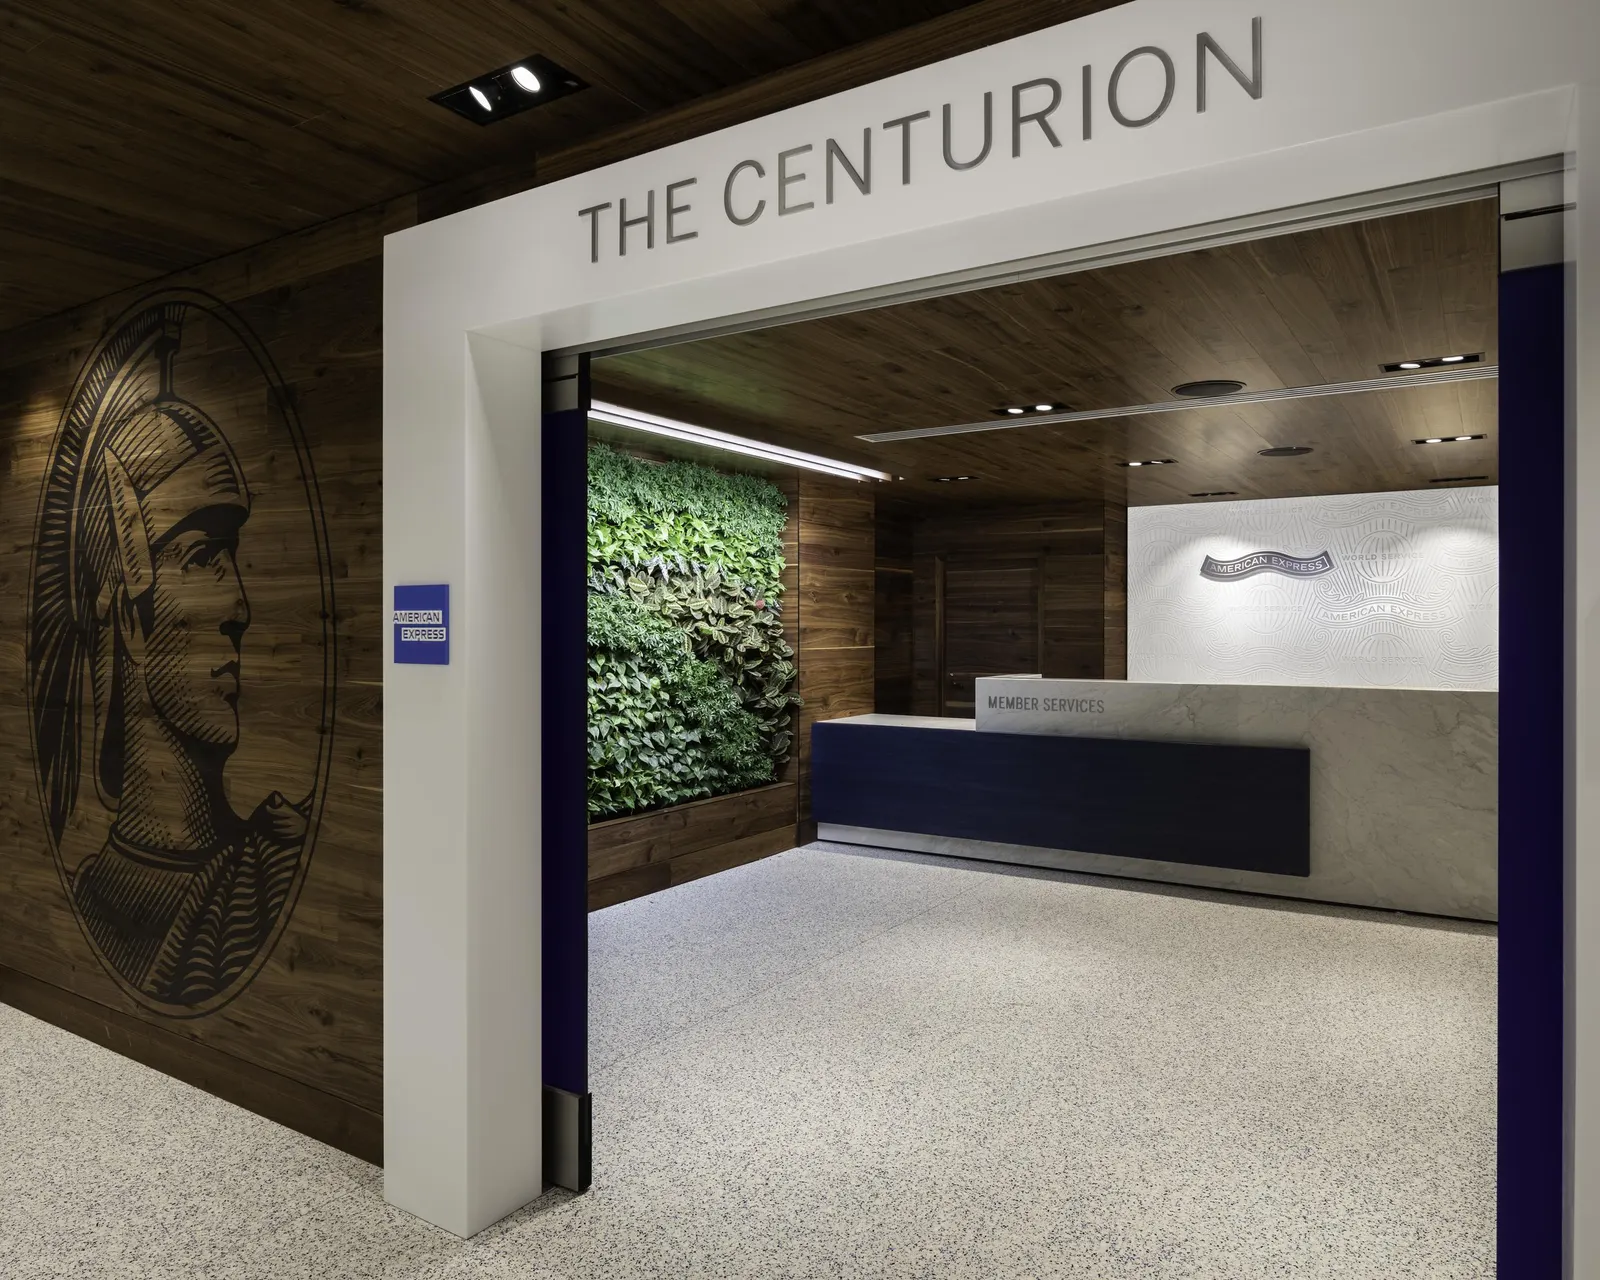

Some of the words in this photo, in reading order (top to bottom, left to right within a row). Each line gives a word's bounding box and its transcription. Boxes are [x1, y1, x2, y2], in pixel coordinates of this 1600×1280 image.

[579, 177, 698, 263] THE
[723, 16, 1263, 227] CENTURION
[1322, 502, 1386, 521] AMERICAN
[1390, 502, 1447, 517] EXPRESS
[1210, 556, 1268, 573] AMERICAN
[1271, 556, 1323, 571] EXPRESS
[1342, 553, 1377, 561] WORLD
[1381, 552, 1425, 560] SERVICE
[393, 612, 440, 622] AMERICAN
[1322, 604, 1386, 621] AMERICAN
[1390, 604, 1447, 621] EXPRESS
[403, 629, 444, 639] EXPRESS
[988, 696, 1039, 711] MEMBER
[1043, 698, 1105, 714] SERVICES
